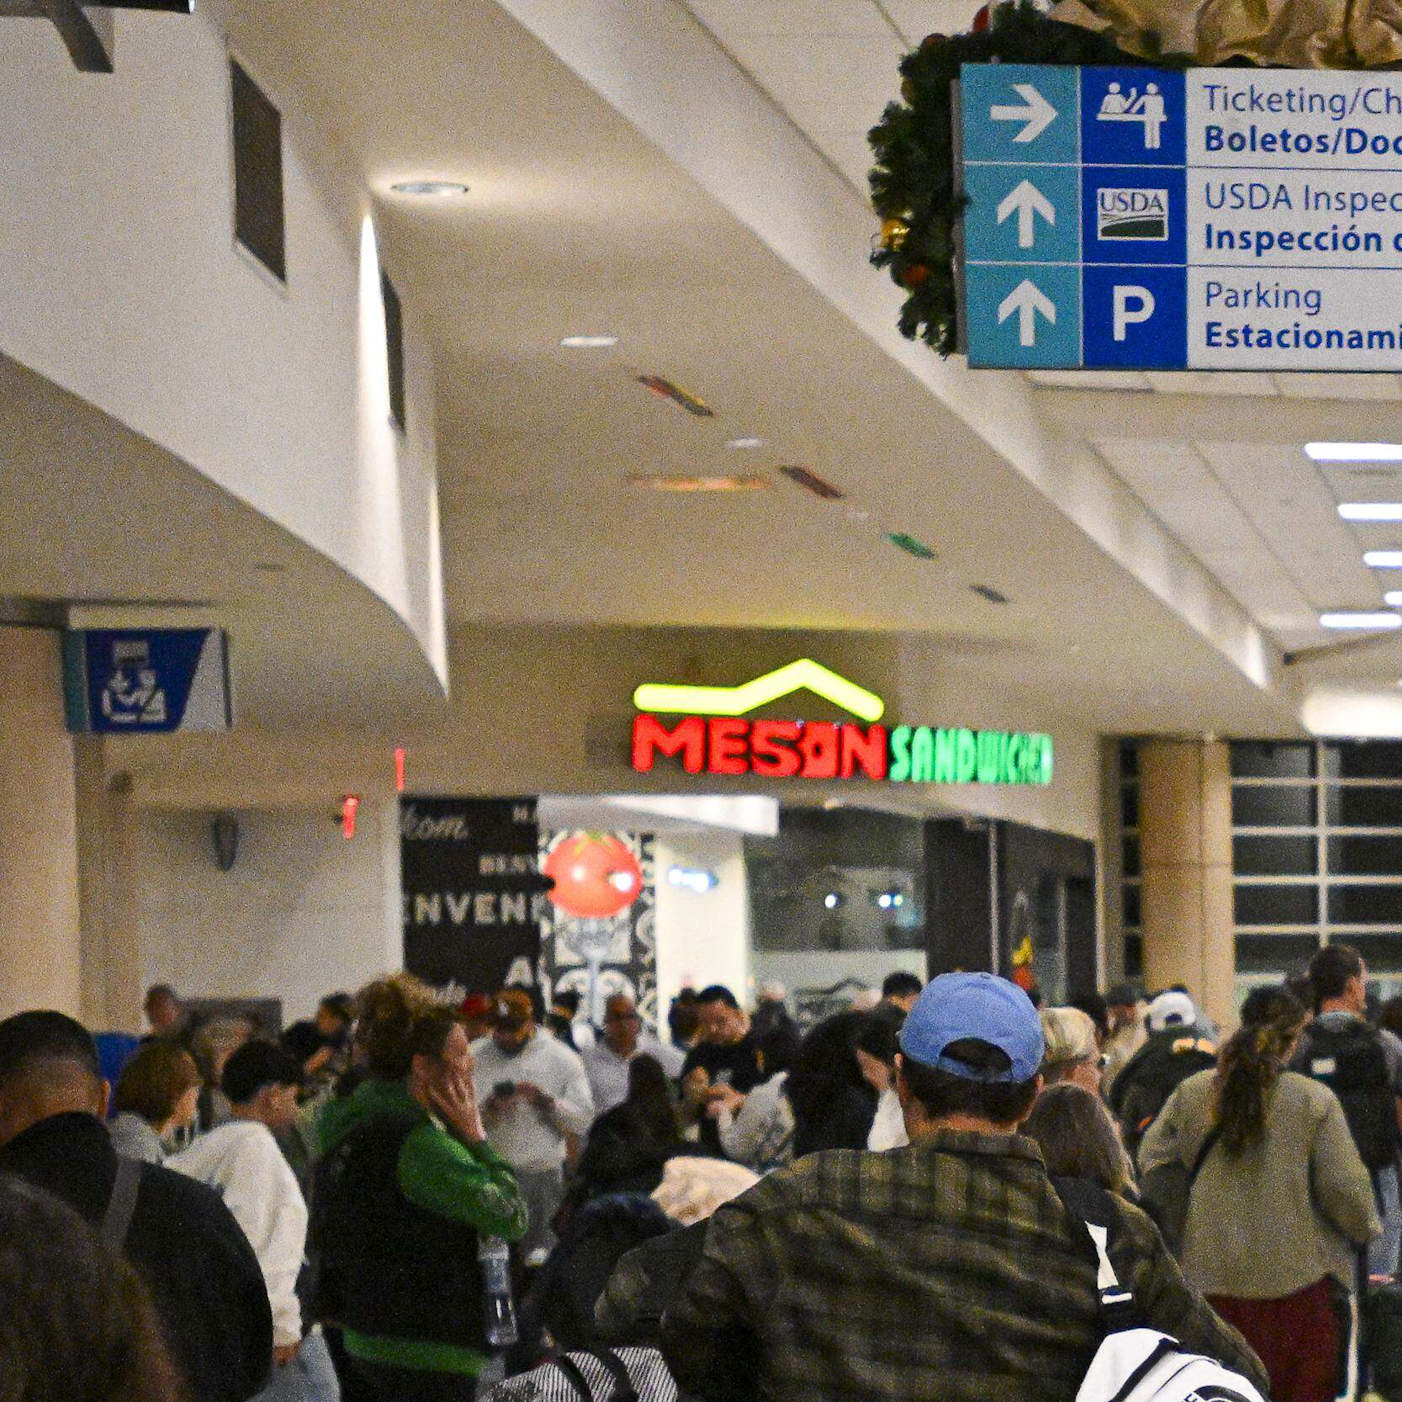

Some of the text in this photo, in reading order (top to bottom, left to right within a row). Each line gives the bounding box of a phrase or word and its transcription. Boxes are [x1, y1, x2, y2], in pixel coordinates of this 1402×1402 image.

[1100, 191, 1165, 213] USDA
[1204, 182, 1292, 210] USDA
[1205, 222, 1382, 257] Inspección
[1113, 285, 1156, 341] P
[1205, 281, 1321, 316] Parking
